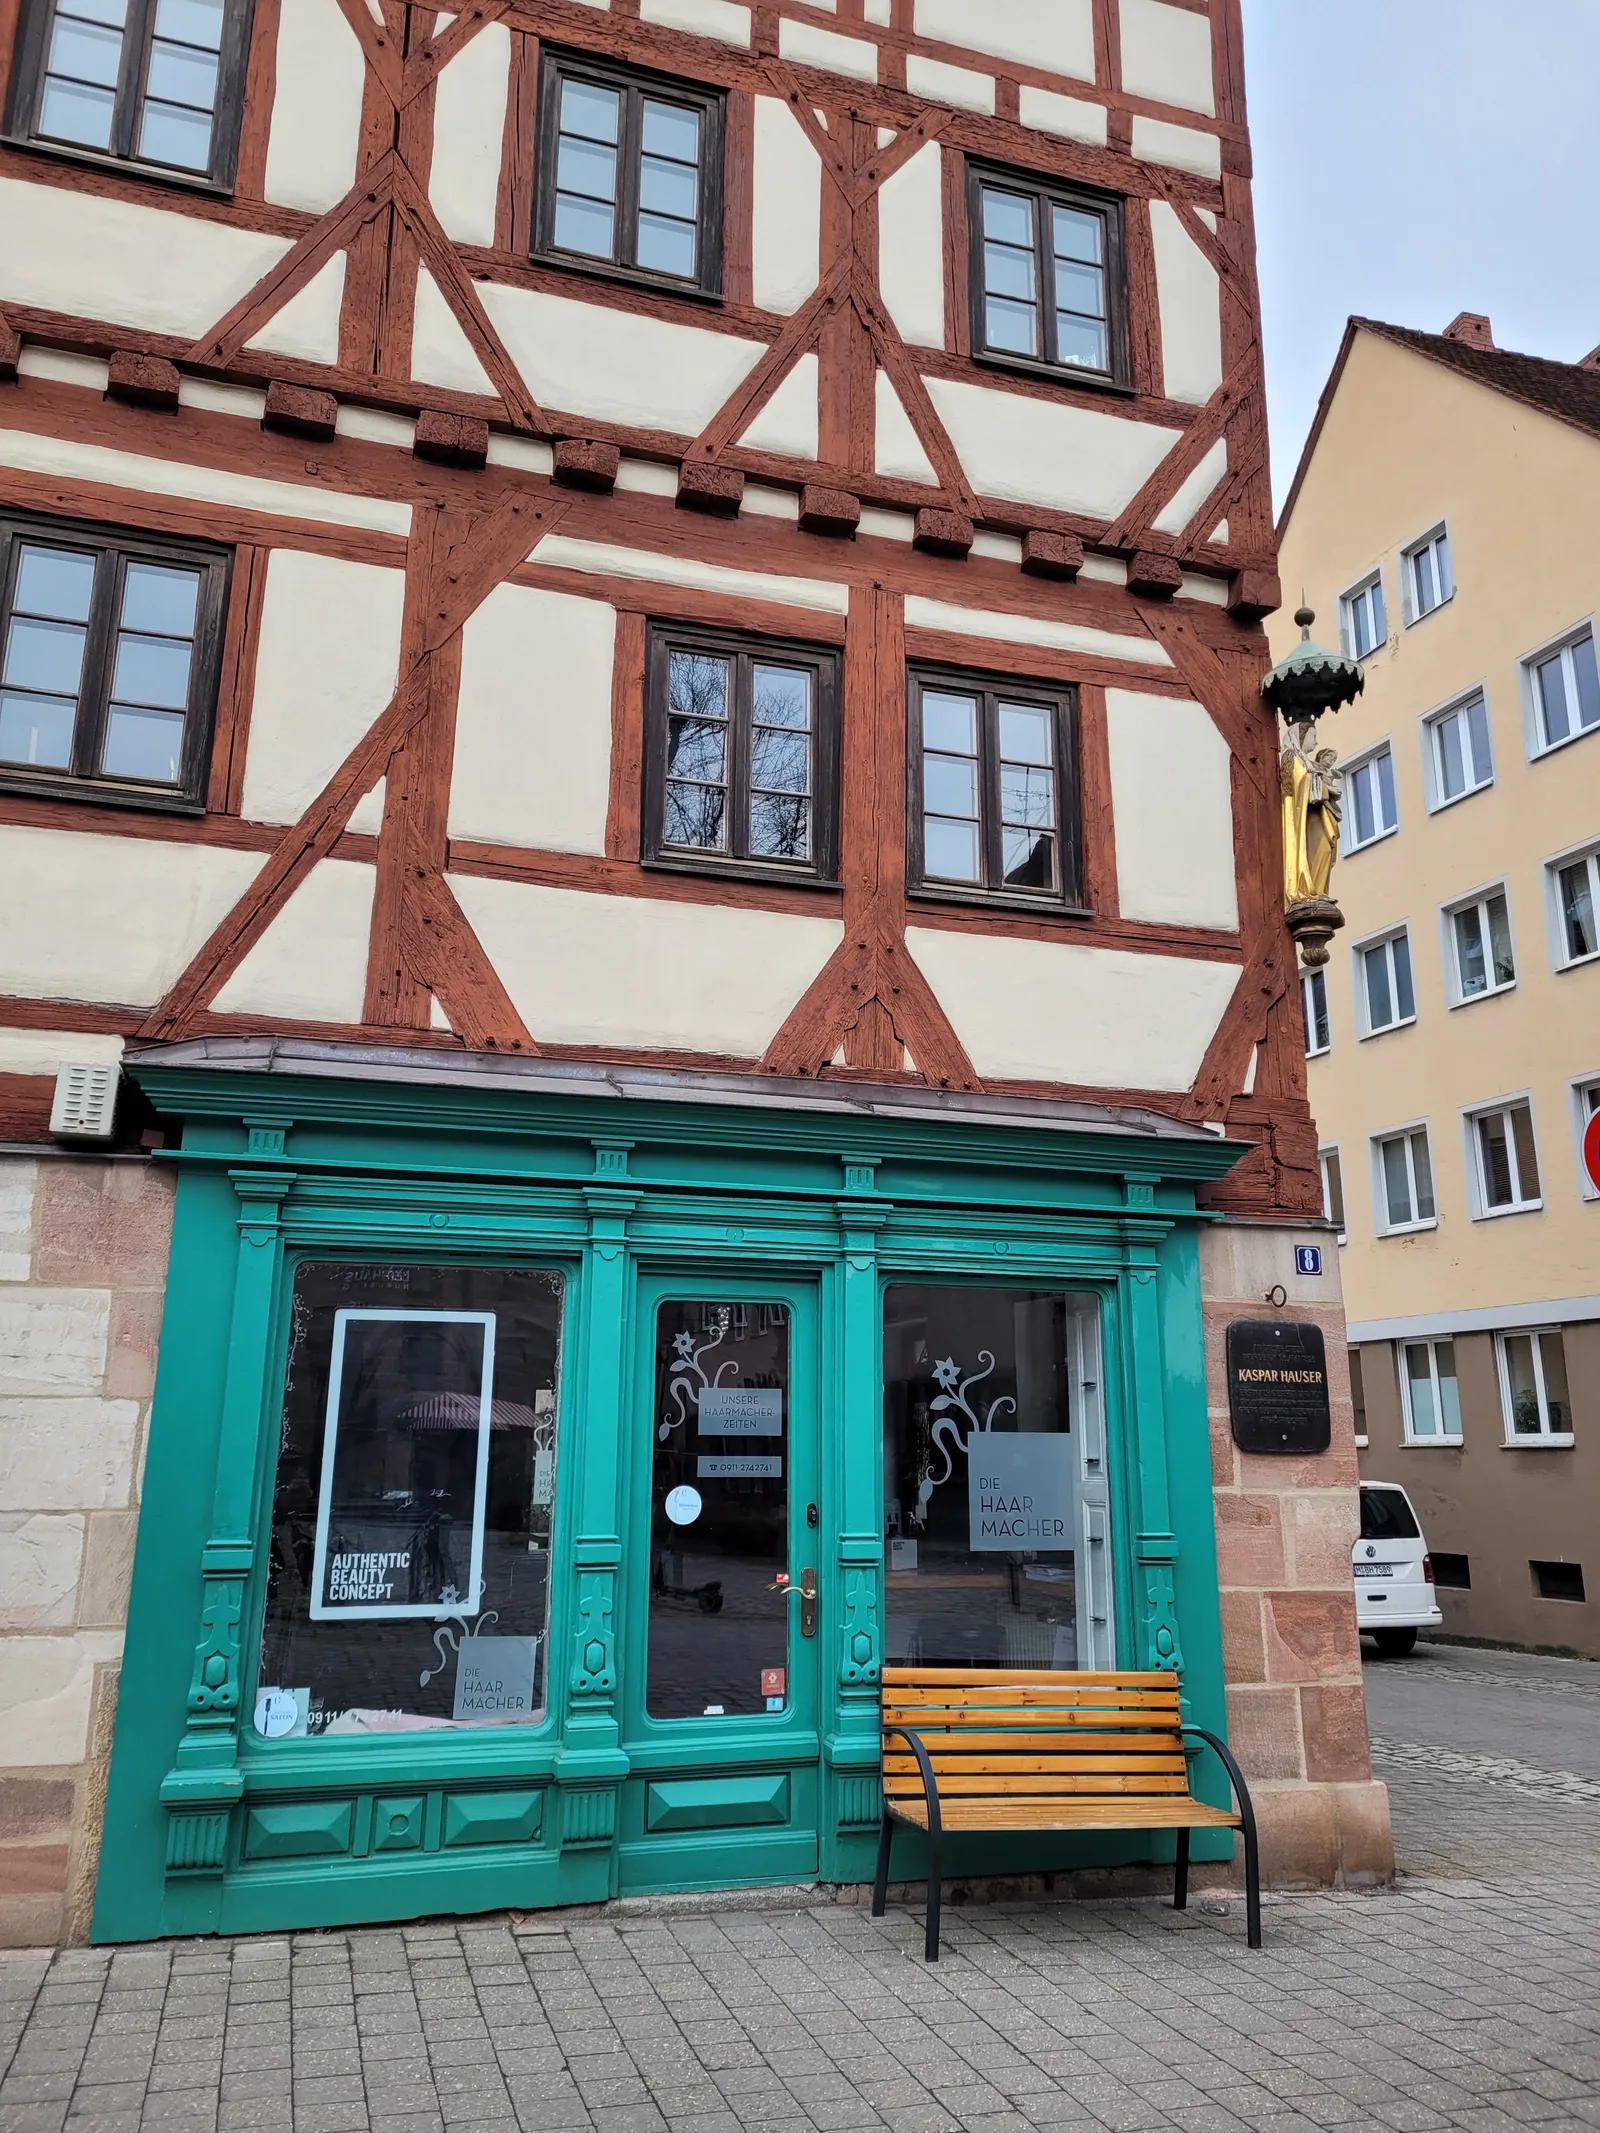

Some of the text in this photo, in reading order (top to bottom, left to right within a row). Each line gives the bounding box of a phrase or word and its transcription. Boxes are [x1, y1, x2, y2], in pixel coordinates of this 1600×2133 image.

[1304, 1249, 1314, 1271] 8
[1238, 1368, 1322, 1383] KASPAR HAUSER
[721, 1395, 759, 1405] UNSERE
[704, 1407, 776, 1417] HAARMACHER-
[723, 1419, 757, 1429] ZEITEN
[720, 1463, 772, 1472] 0911 2742741
[979, 1477, 1001, 1490] DIE
[980, 1495, 1034, 1513] HAAR
[981, 1519, 1065, 1537] MACHER
[331, 1552, 411, 1570] AUTHENTIC
[330, 1568, 387, 1585] BEAUTY
[329, 1583, 394, 1600] CONCEPT
[464, 1668, 481, 1677] DIE
[463, 1680, 504, 1693] HAAR
[461, 1696, 525, 1710] MACHER
